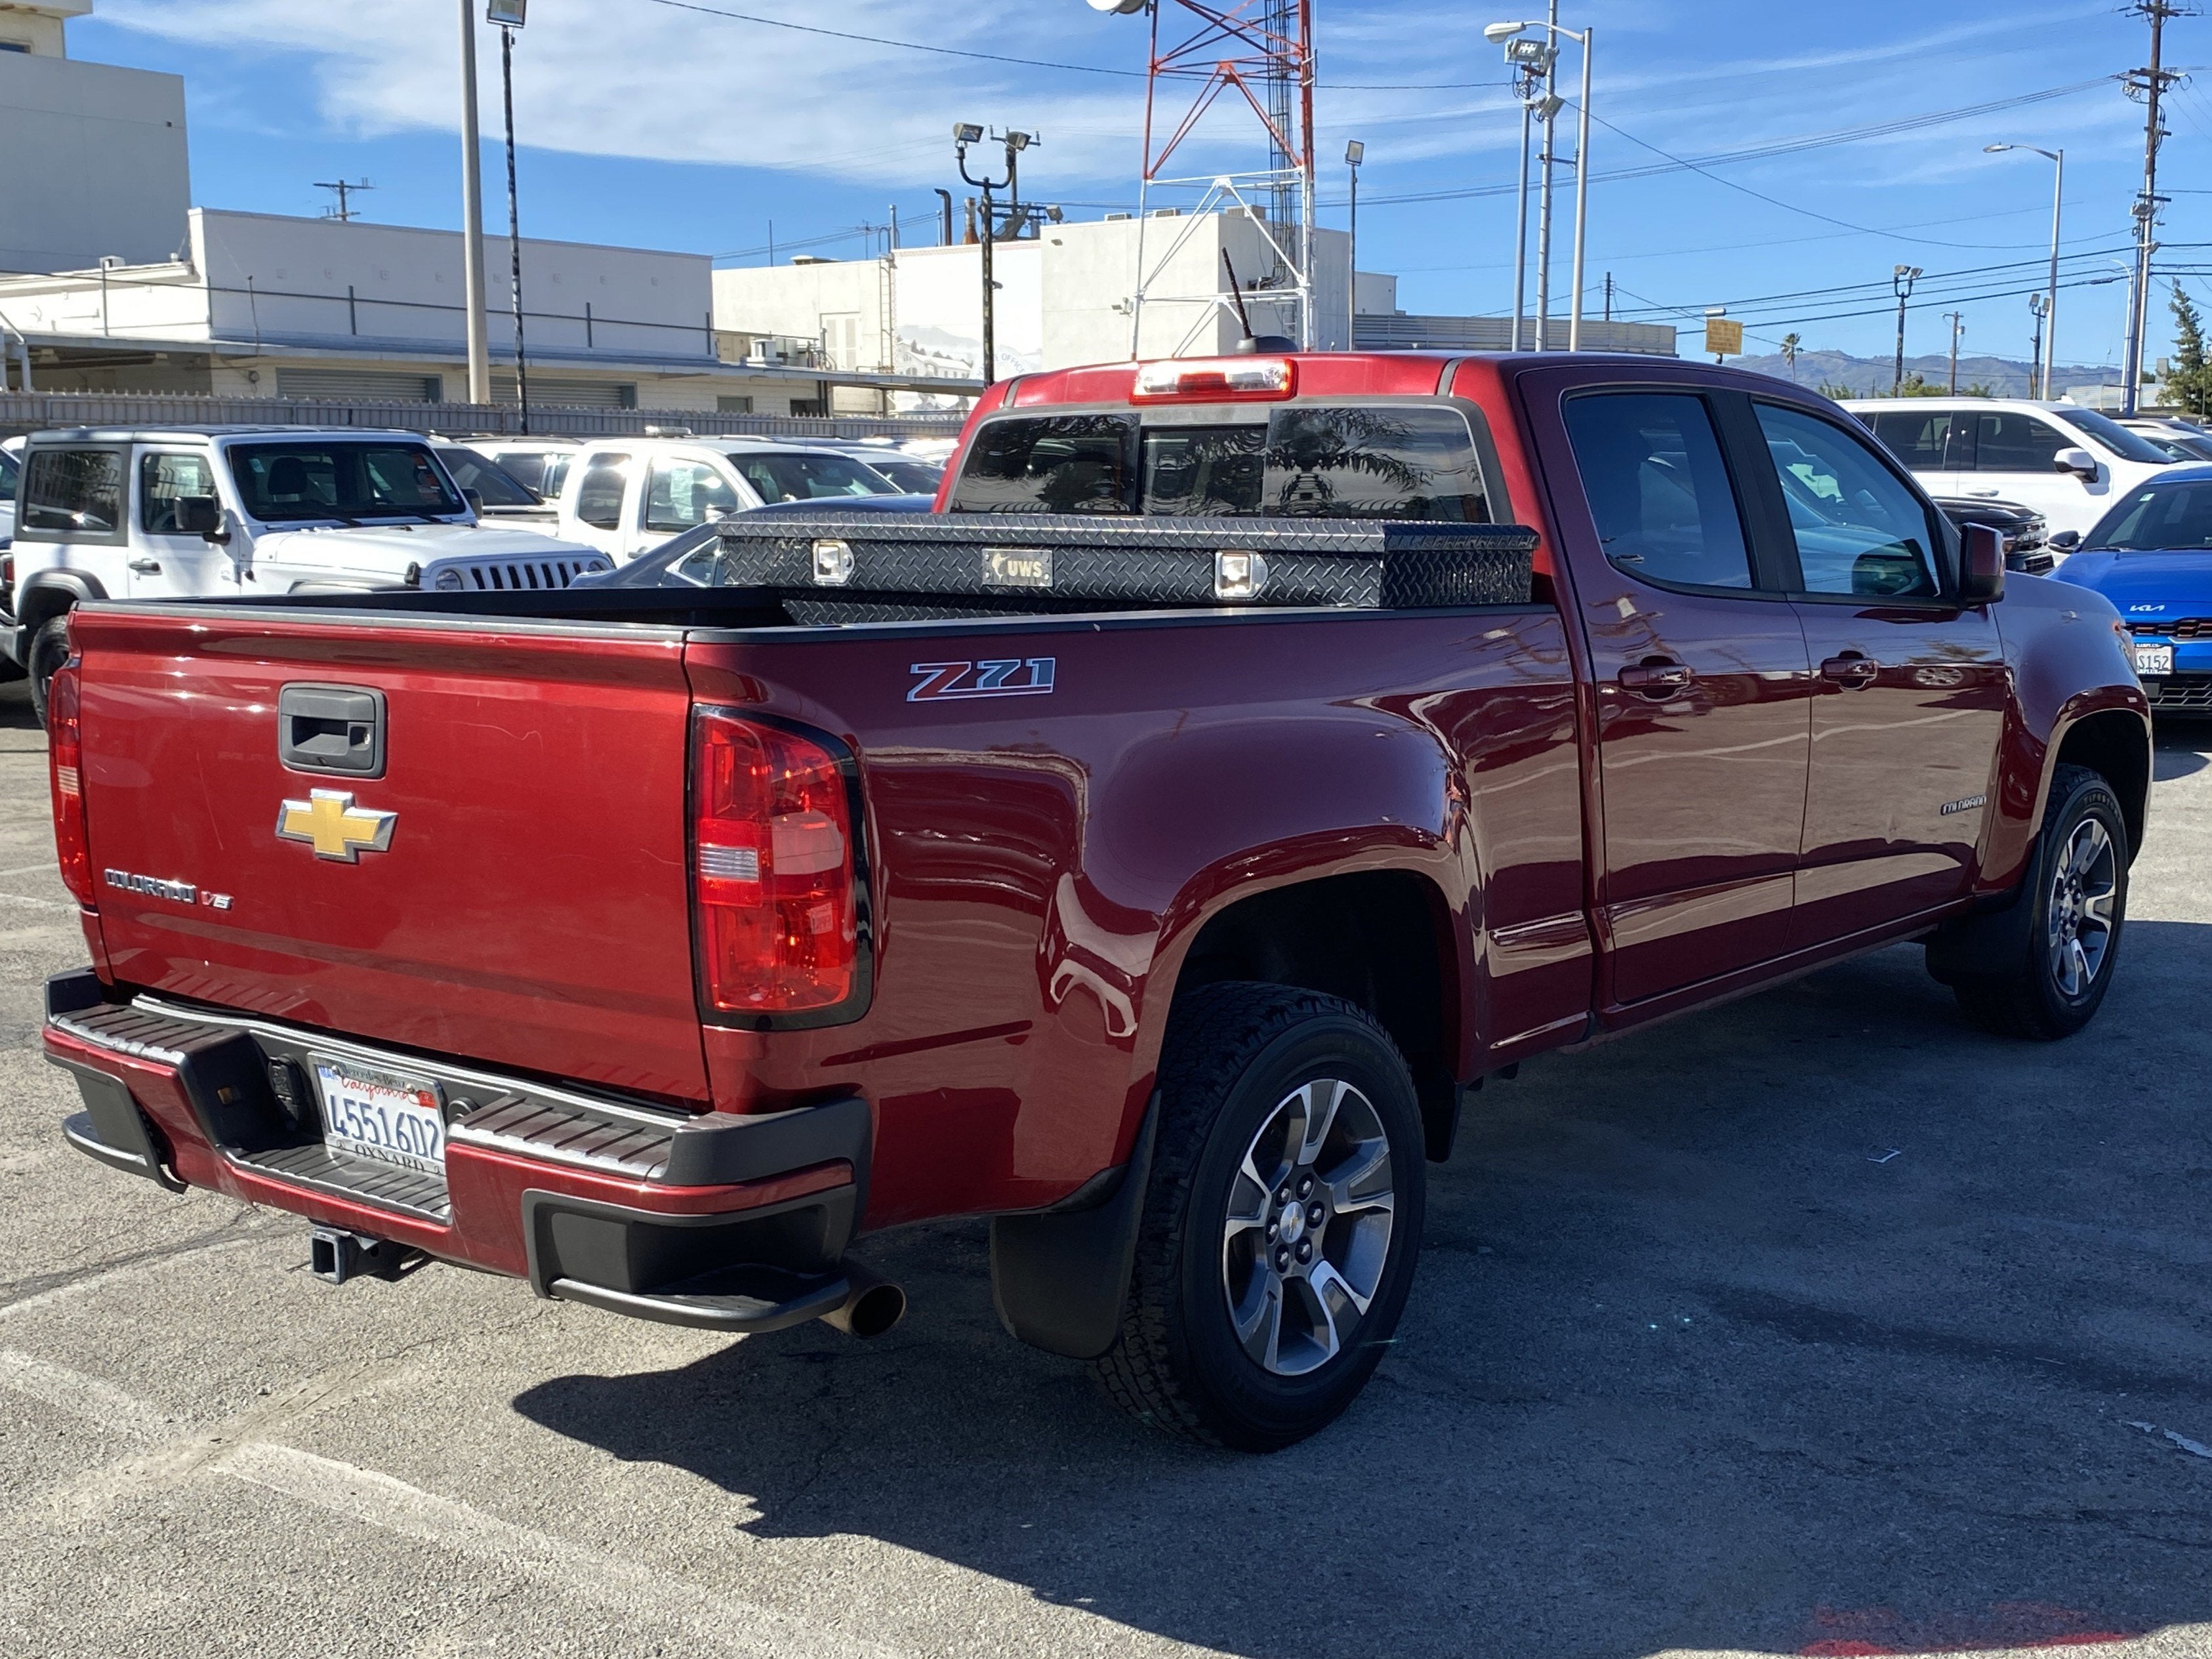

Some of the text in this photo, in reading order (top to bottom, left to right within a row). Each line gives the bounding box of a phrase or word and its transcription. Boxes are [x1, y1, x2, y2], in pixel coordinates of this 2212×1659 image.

[1008, 560, 1042, 577] UWS
[907, 657, 1055, 701] Z71
[2138, 655, 2169, 669] S152
[104, 868, 234, 910] COLORADO V6
[330, 1095, 445, 1162] 45516D2
[355, 1144, 425, 1172] OXNARD
